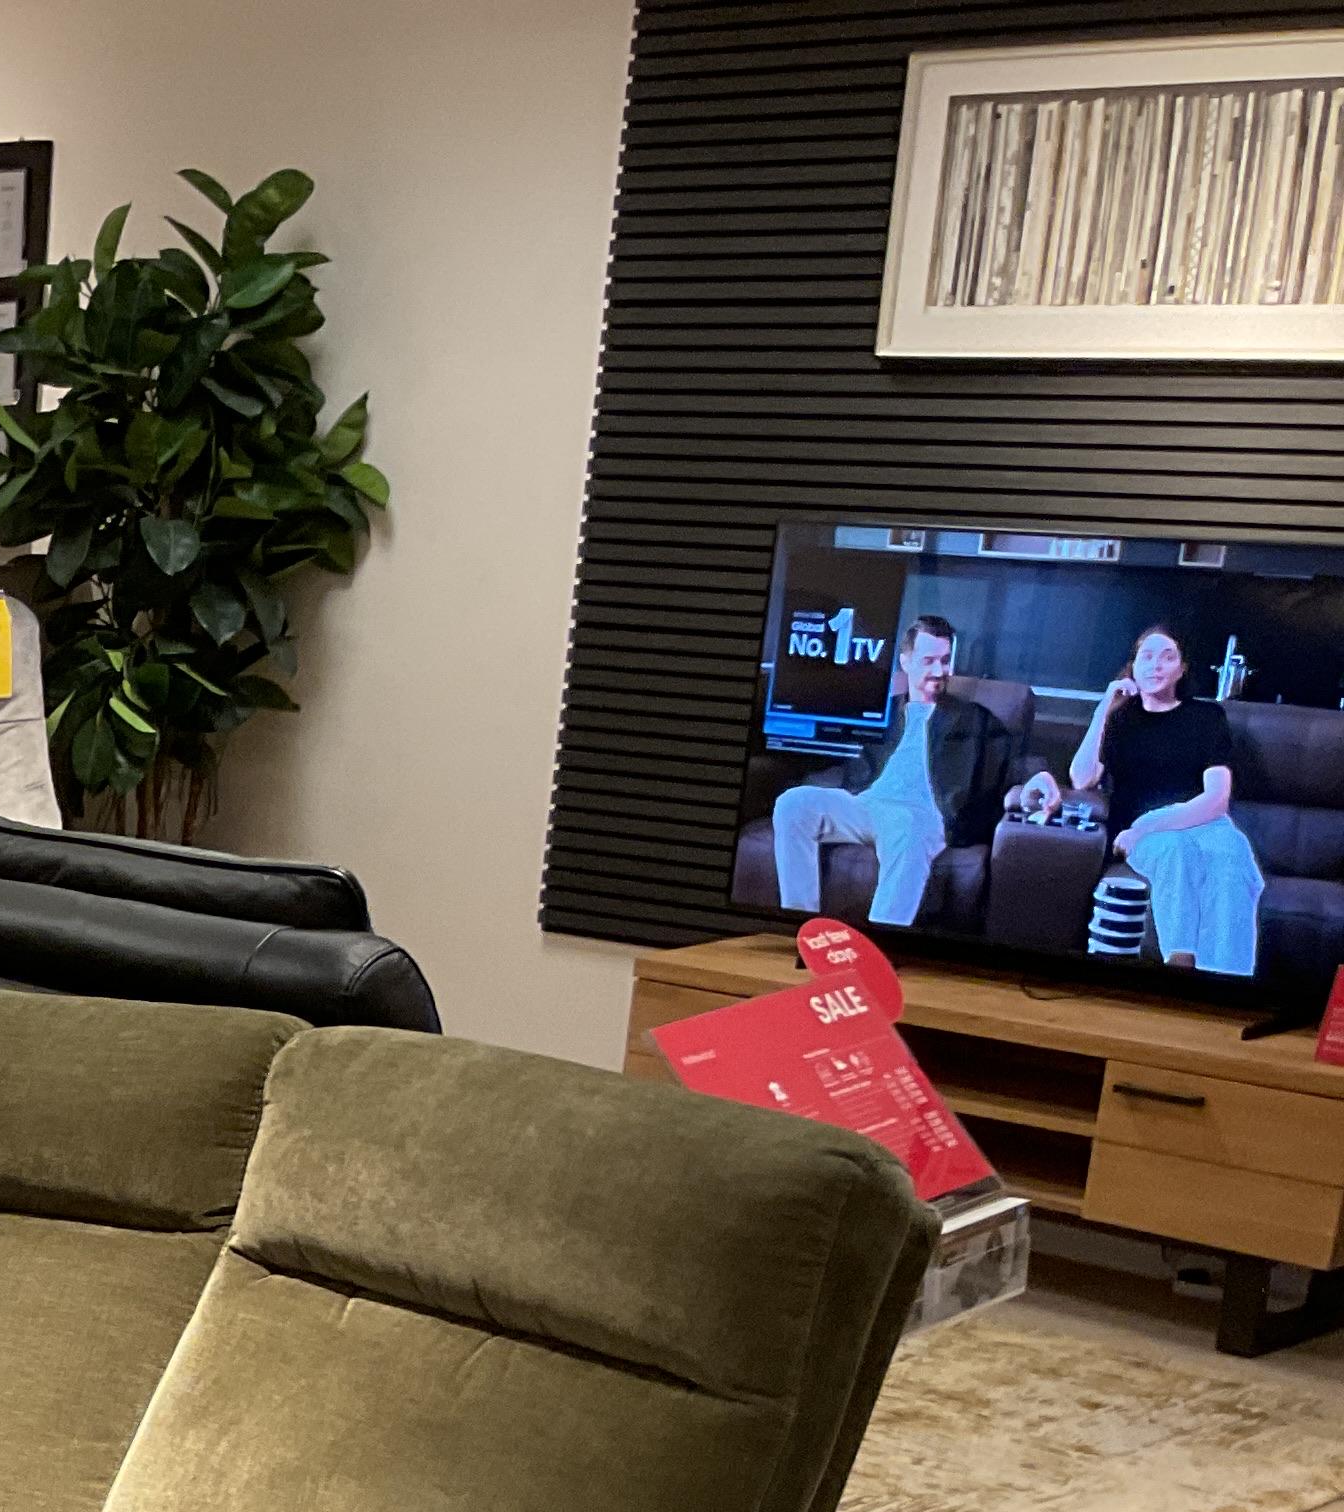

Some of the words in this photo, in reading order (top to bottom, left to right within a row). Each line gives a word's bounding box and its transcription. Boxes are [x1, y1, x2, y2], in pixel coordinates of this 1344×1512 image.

[789, 633, 827, 658] No.
[828, 608, 854, 664] 1
[852, 638, 885, 662] TV
[810, 986, 868, 1024] SALE
